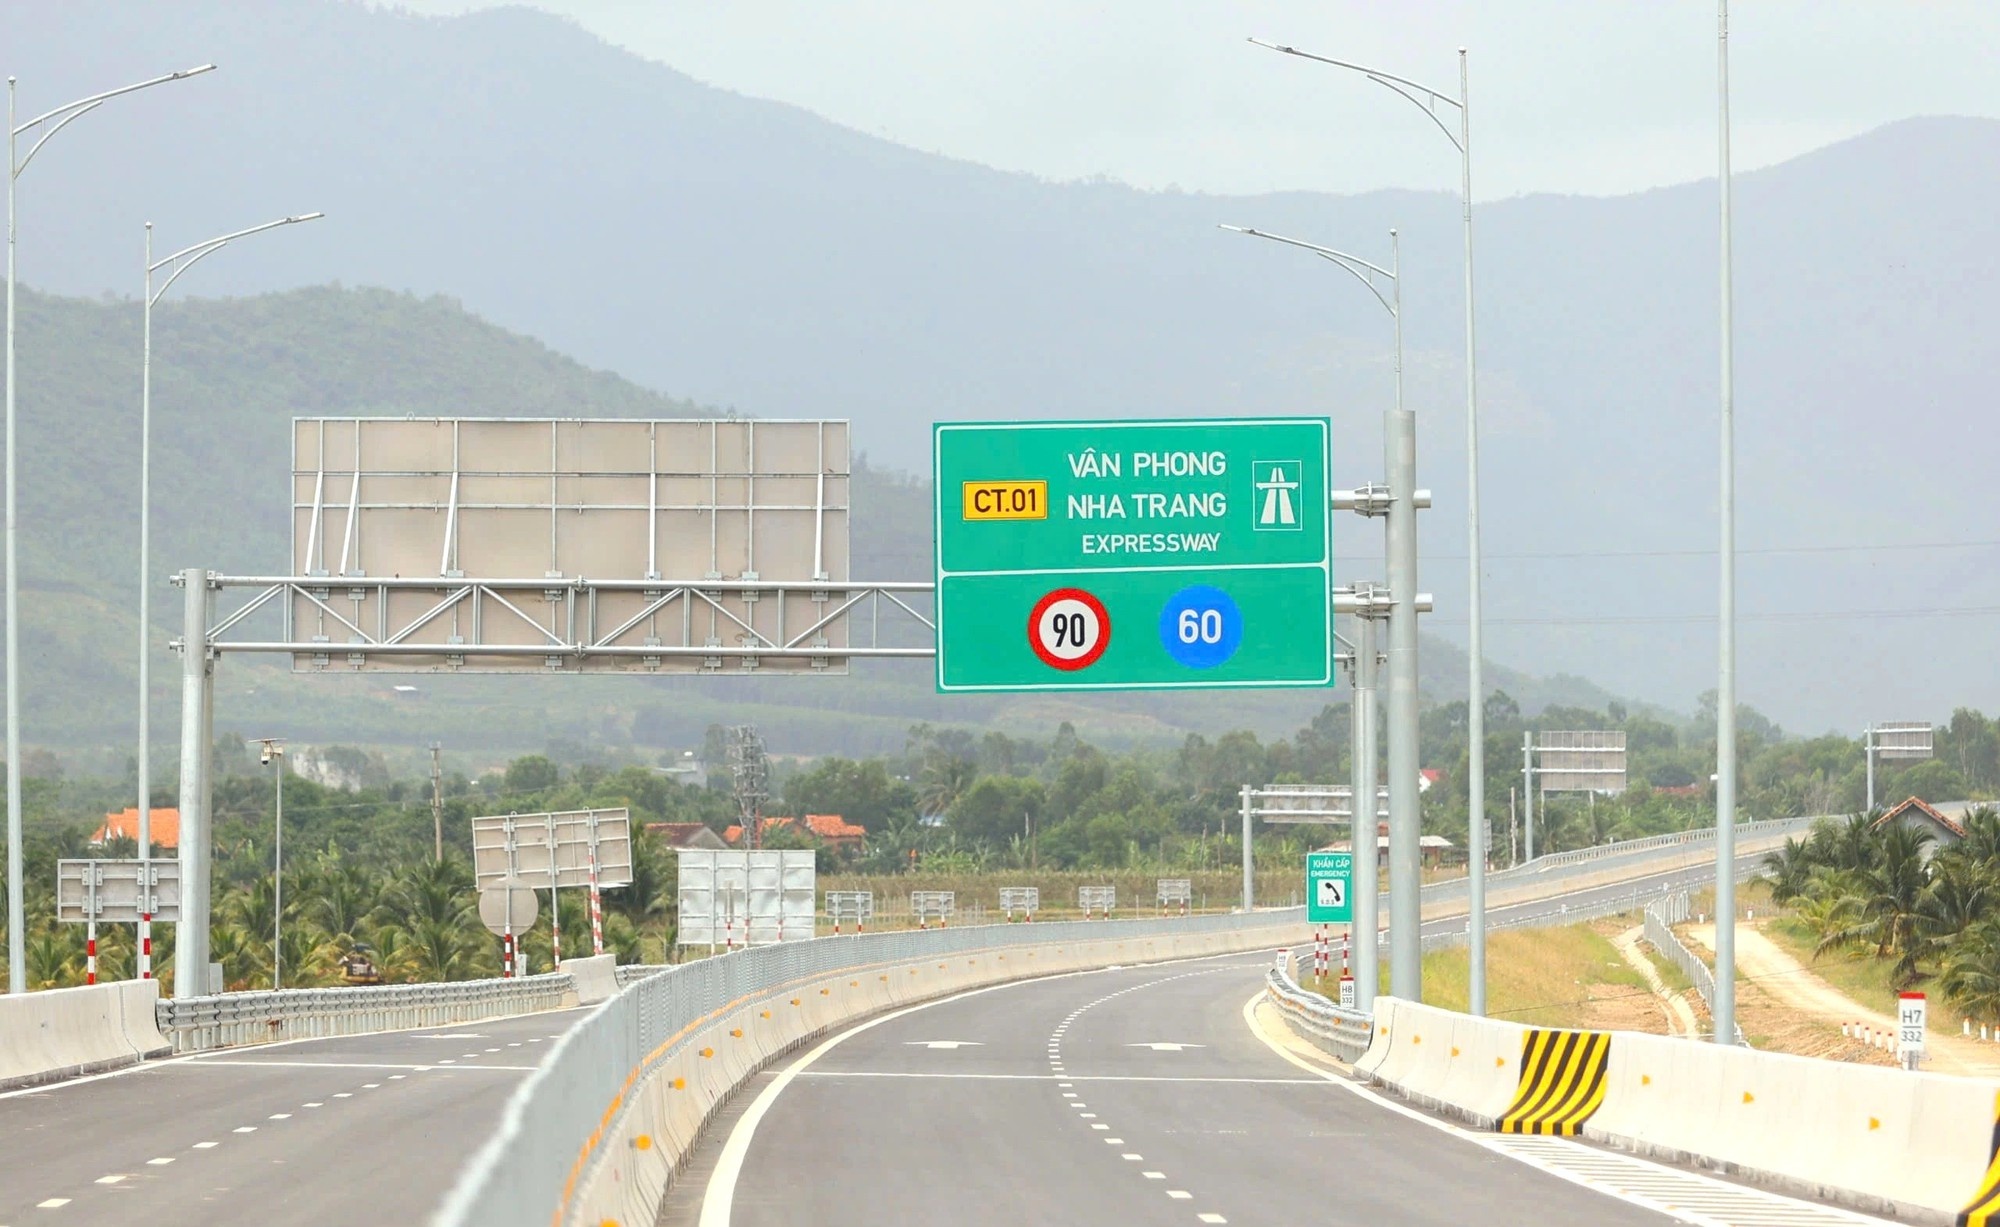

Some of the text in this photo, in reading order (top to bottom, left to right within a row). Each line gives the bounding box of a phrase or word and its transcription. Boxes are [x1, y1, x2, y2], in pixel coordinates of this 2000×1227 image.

[1068, 447, 1226, 478] VÂN PHONG
[974, 488, 1037, 513] CT.01
[1067, 492, 1227, 519] NHA TRANG
[1082, 532, 1221, 554] EXPRESSWAY
[1053, 613, 1085, 647] 90
[1178, 609, 1222, 644] 60
[1902, 1009, 1922, 1023] H7
[1901, 1030, 1922, 1042] 332
